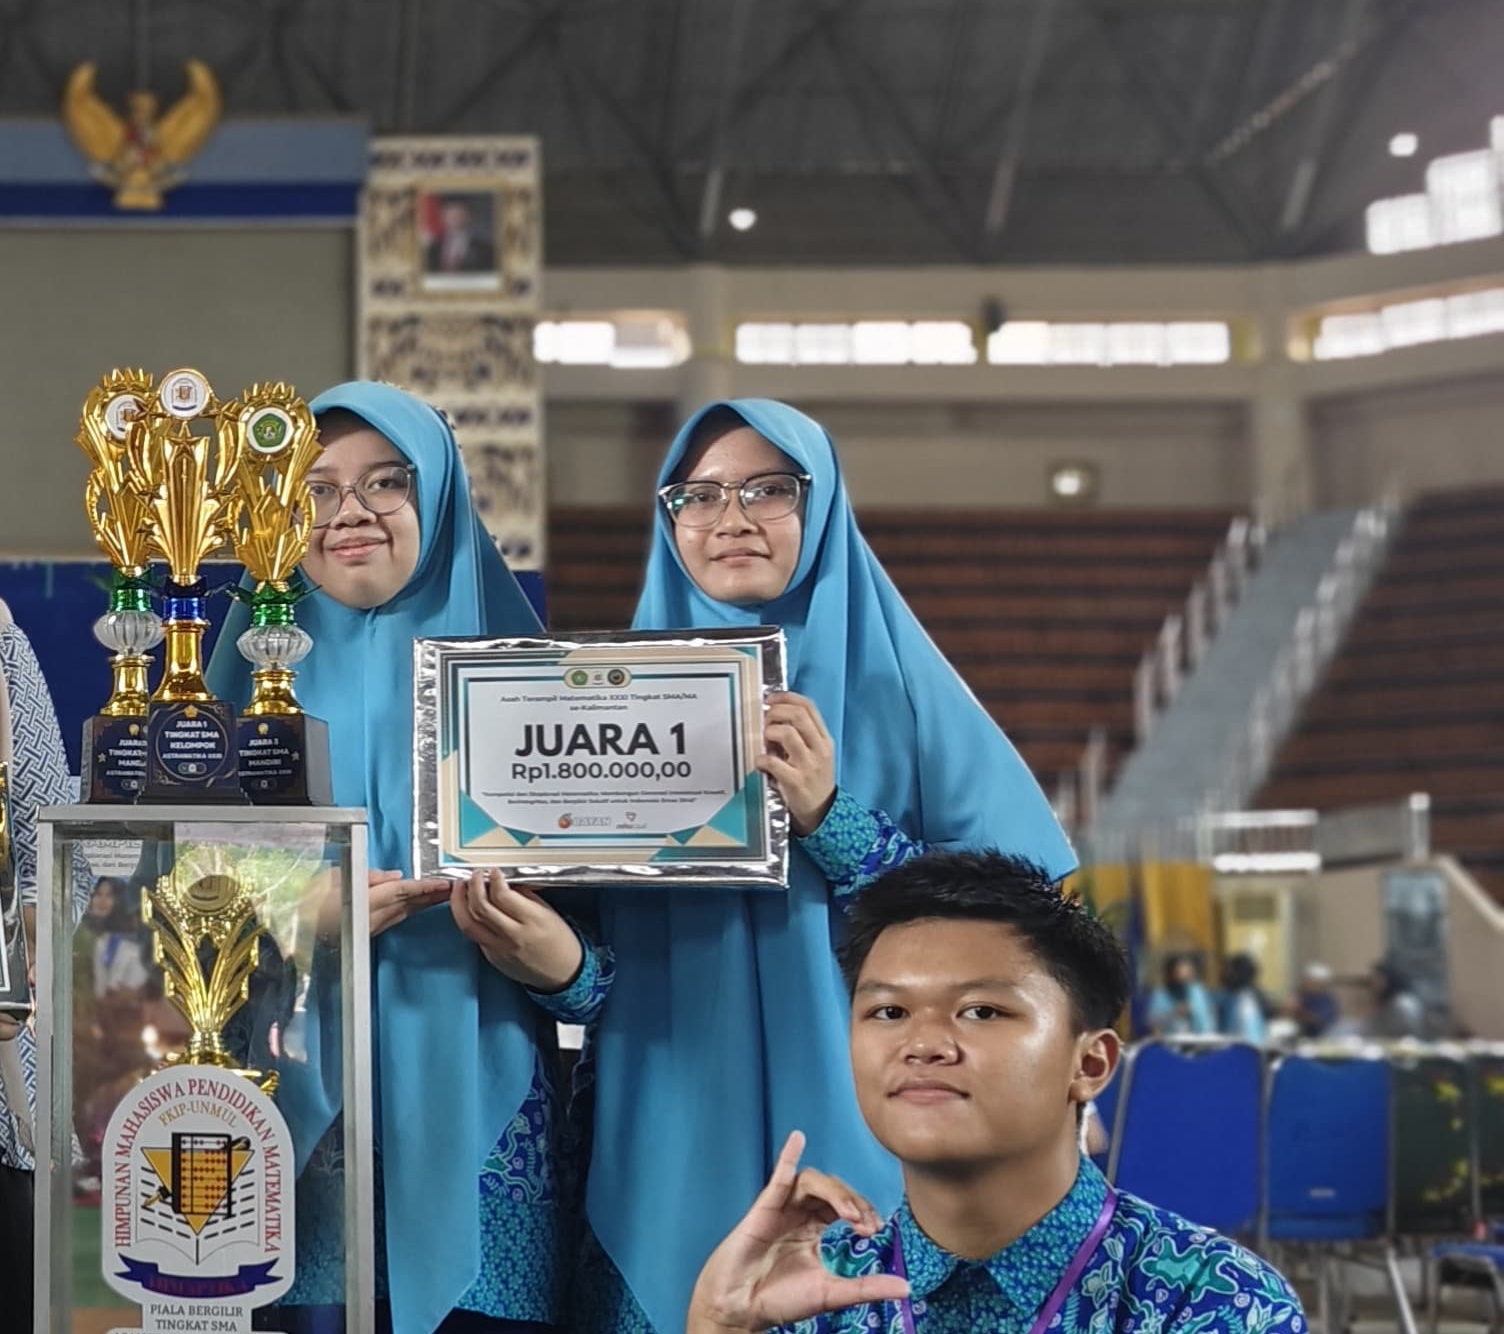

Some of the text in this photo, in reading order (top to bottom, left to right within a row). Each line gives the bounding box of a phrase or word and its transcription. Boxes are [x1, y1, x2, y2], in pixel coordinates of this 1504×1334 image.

[514, 722, 686, 757] JUARA 1
[512, 761, 692, 784] Rp1.800.000,00
[157, 1100, 237, 1129] FKIP-UNMUL
[114, 1078, 282, 1253] HIMPUNAN MAHASISWA PENDIDIKAN MATEMATIKA
[150, 1304, 244, 1317] PIALA BERGILIR
[155, 1319, 238, 1332] TINGKAT SMA
